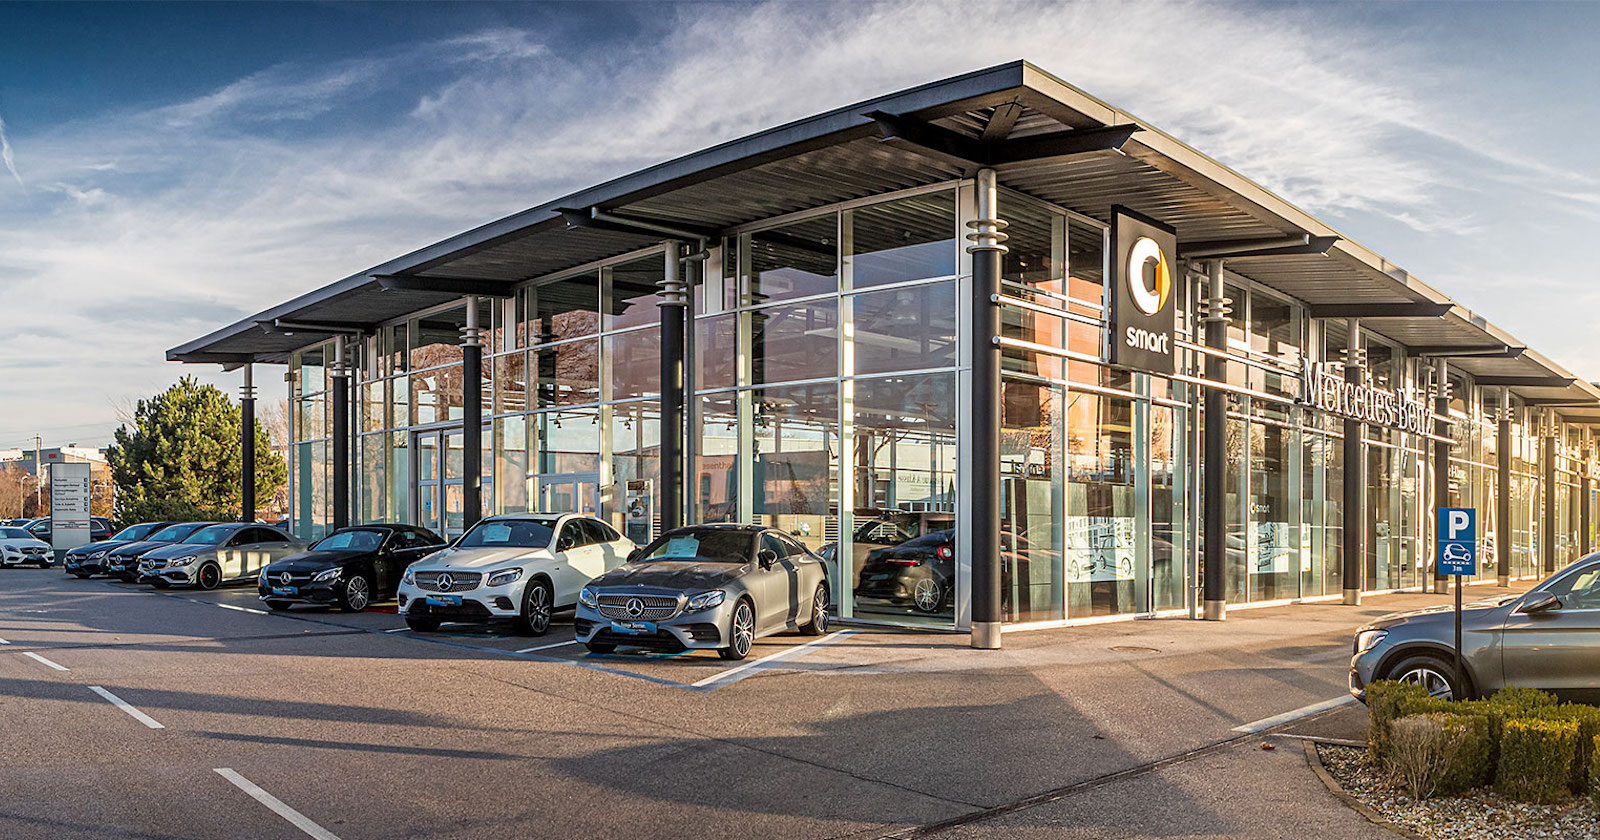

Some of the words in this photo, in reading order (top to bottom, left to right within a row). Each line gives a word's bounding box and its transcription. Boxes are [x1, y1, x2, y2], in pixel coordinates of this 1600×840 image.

[1126, 326, 1168, 354] smart
[1302, 357, 1433, 436] Mercedes-Benz
[1449, 511, 1469, 539] P
